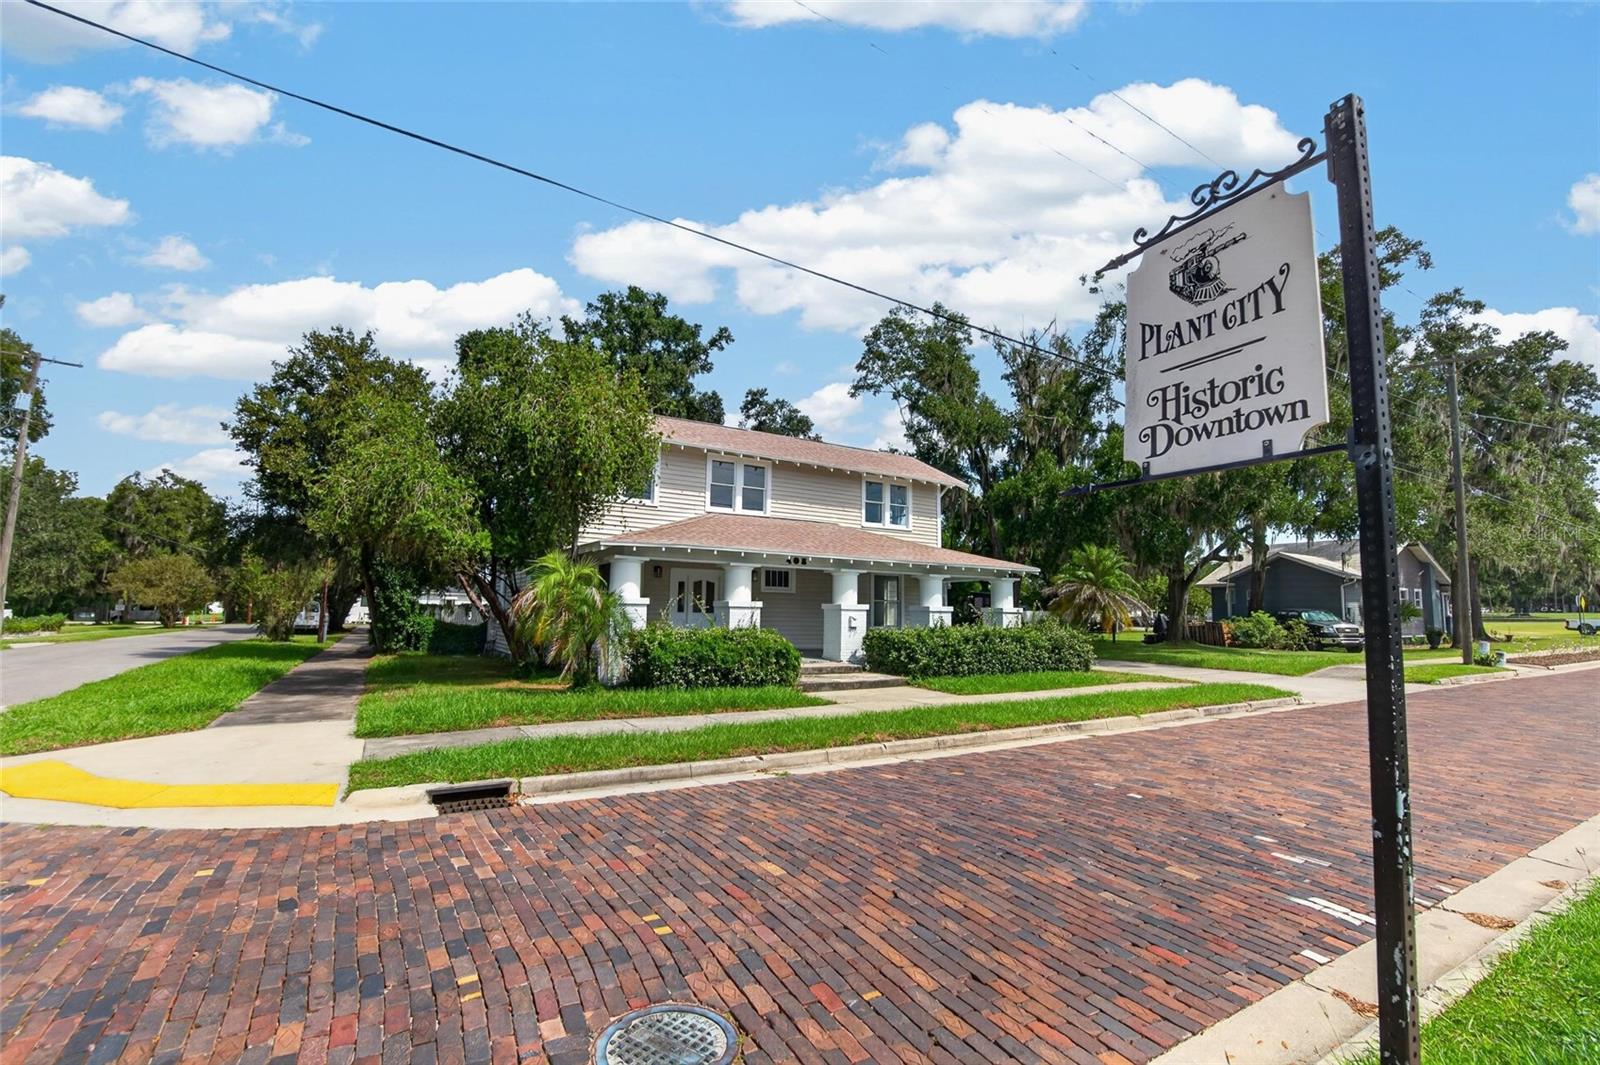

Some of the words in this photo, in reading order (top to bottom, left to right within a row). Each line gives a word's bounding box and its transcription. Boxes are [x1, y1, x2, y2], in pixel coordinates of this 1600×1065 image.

[1138, 309, 1217, 361] PLANT
[1222, 262, 1291, 331] CITY
[1146, 364, 1285, 425] Historic
[1138, 399, 1311, 459] Downtown
